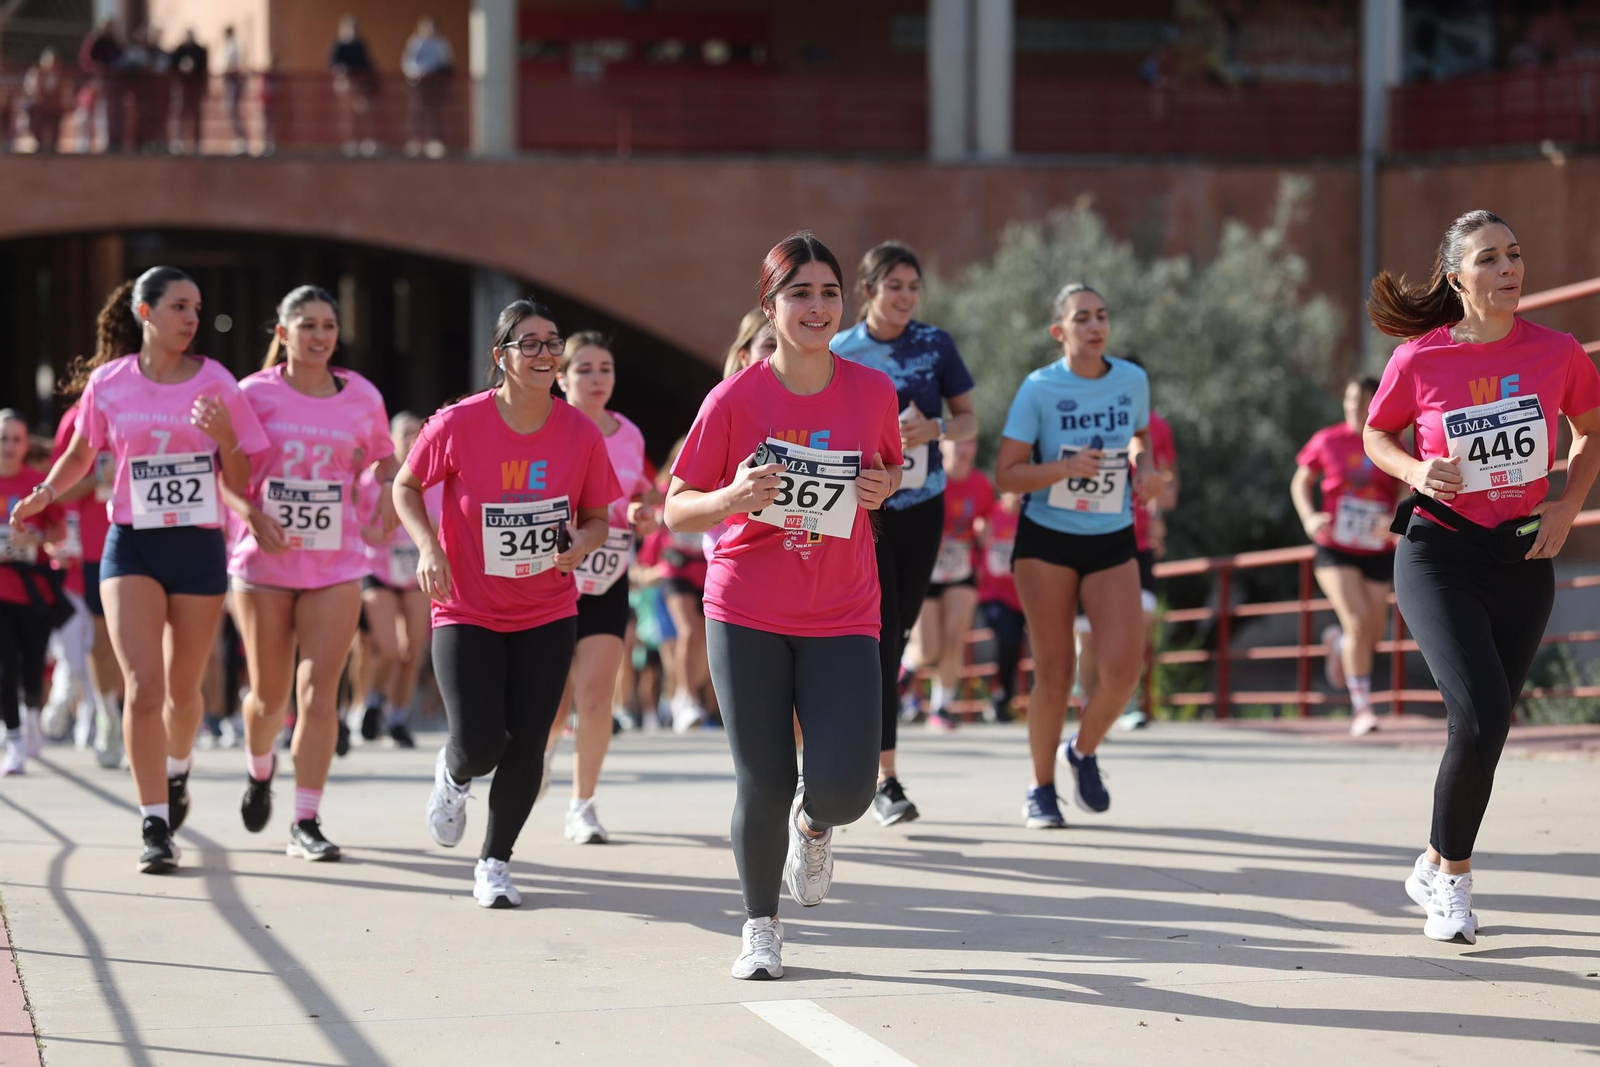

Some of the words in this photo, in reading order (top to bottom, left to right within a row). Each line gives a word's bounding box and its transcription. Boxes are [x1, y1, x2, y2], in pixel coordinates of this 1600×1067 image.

[1061, 406, 1129, 431] nerja
[1449, 418, 1495, 436] UMA
[1468, 426, 1536, 465] 446
[134, 465, 171, 479] UMA
[501, 460, 548, 490] WE
[780, 458, 810, 474] MA
[1491, 473, 1508, 484] WE
[147, 478, 203, 505] 482
[773, 475, 845, 512] 367
[279, 504, 331, 530] 356
[487, 515, 528, 527] UMA
[786, 517, 802, 526] WE
[499, 527, 558, 557] 349
[516, 564, 530, 575] WE
